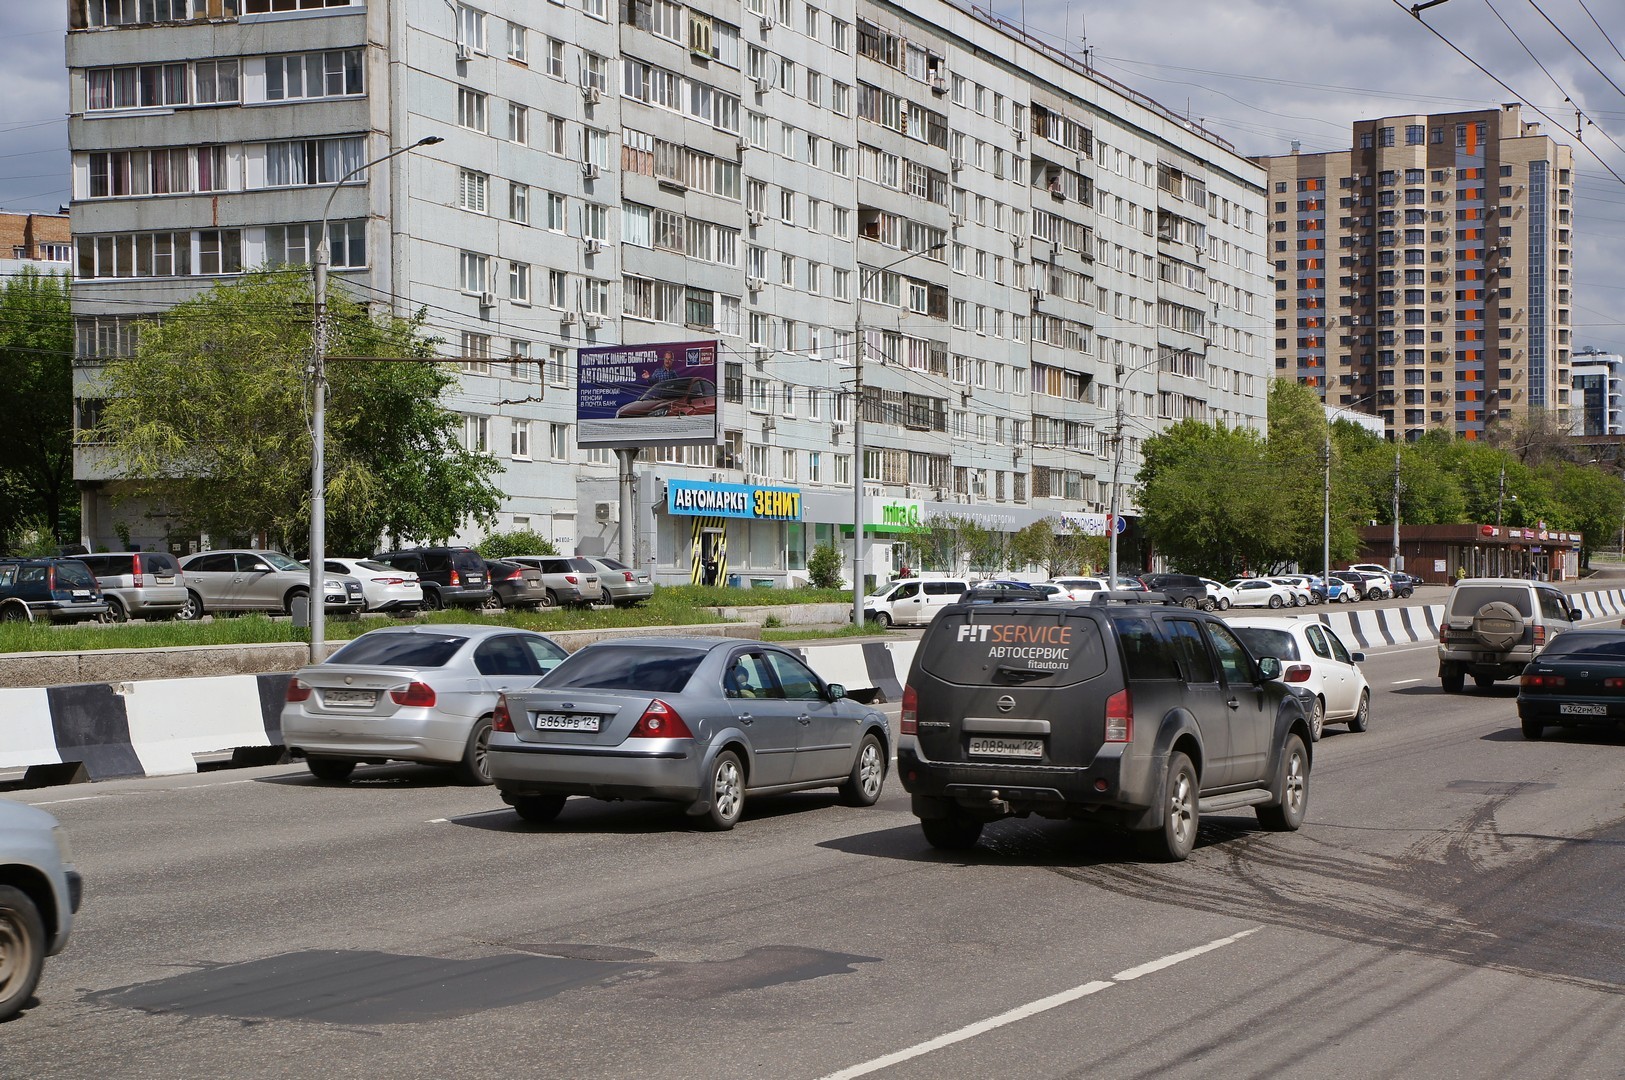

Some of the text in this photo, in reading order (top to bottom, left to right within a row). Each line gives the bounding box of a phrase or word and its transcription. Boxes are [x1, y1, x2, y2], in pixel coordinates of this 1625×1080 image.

[581, 350, 658, 366] ПОЛУЧИТЕ ШАНС ВЫИГРАТЬ
[580, 366, 637, 383] АВТОМОБИЛЬ
[675, 488, 800, 517] АВТОМАРКЕТ ЗЕНИТ
[991, 624, 1073, 645] SERVICE
[988, 646, 1070, 660] АВТОСЕРВИС
[1027, 659, 1069, 670] fitauto.ru
[540, 716, 597, 728] В863РВ 124
[973, 740, 1041, 753] В088ММ 124
